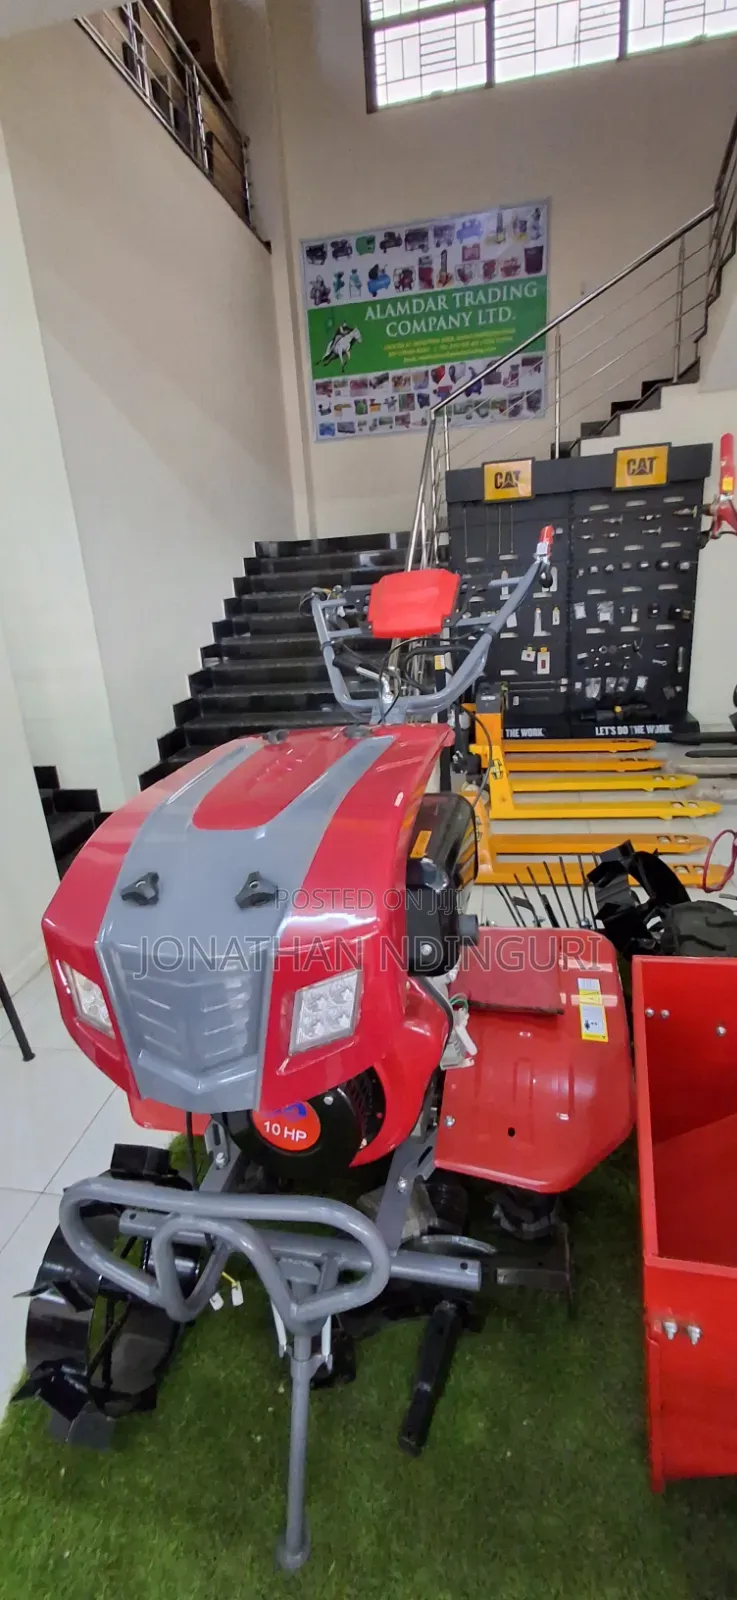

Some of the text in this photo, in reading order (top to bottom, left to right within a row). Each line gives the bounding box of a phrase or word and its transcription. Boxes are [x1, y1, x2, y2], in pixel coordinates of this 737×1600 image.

[364, 281, 538, 321] ALAMDAR TRADING
[386, 306, 516, 337] COMPANY LTD.
[627, 456, 658, 476] CAT
[494, 469, 521, 490] CAT
[505, 728, 520, 738] THE
[595, 725, 617, 736] LET'S
[617, 725, 629, 735] DO
[629, 724, 645, 735] THE
[264, 1120, 307, 1142] 10 HP
